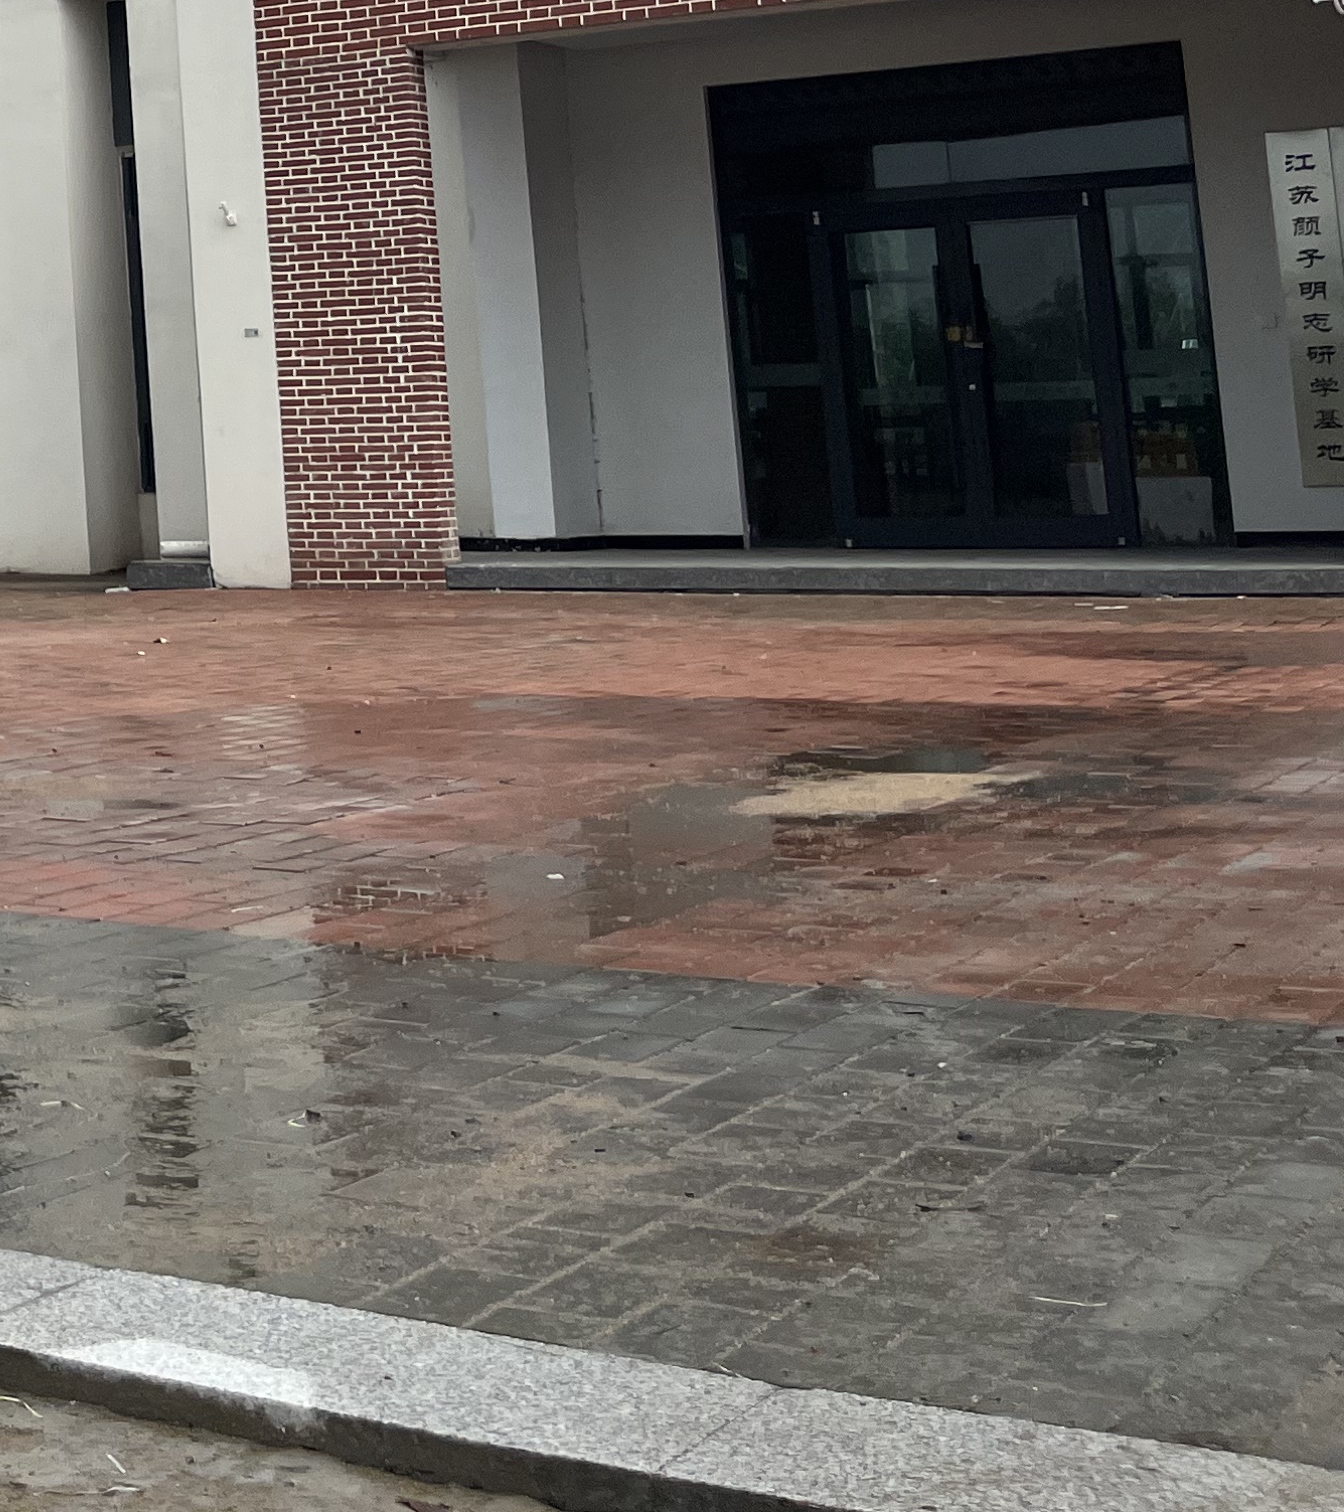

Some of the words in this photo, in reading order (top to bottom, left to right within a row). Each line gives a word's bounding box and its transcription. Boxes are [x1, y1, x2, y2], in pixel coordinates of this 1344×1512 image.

[1284, 152, 1344, 462] 江苏颜子明志研学基地
